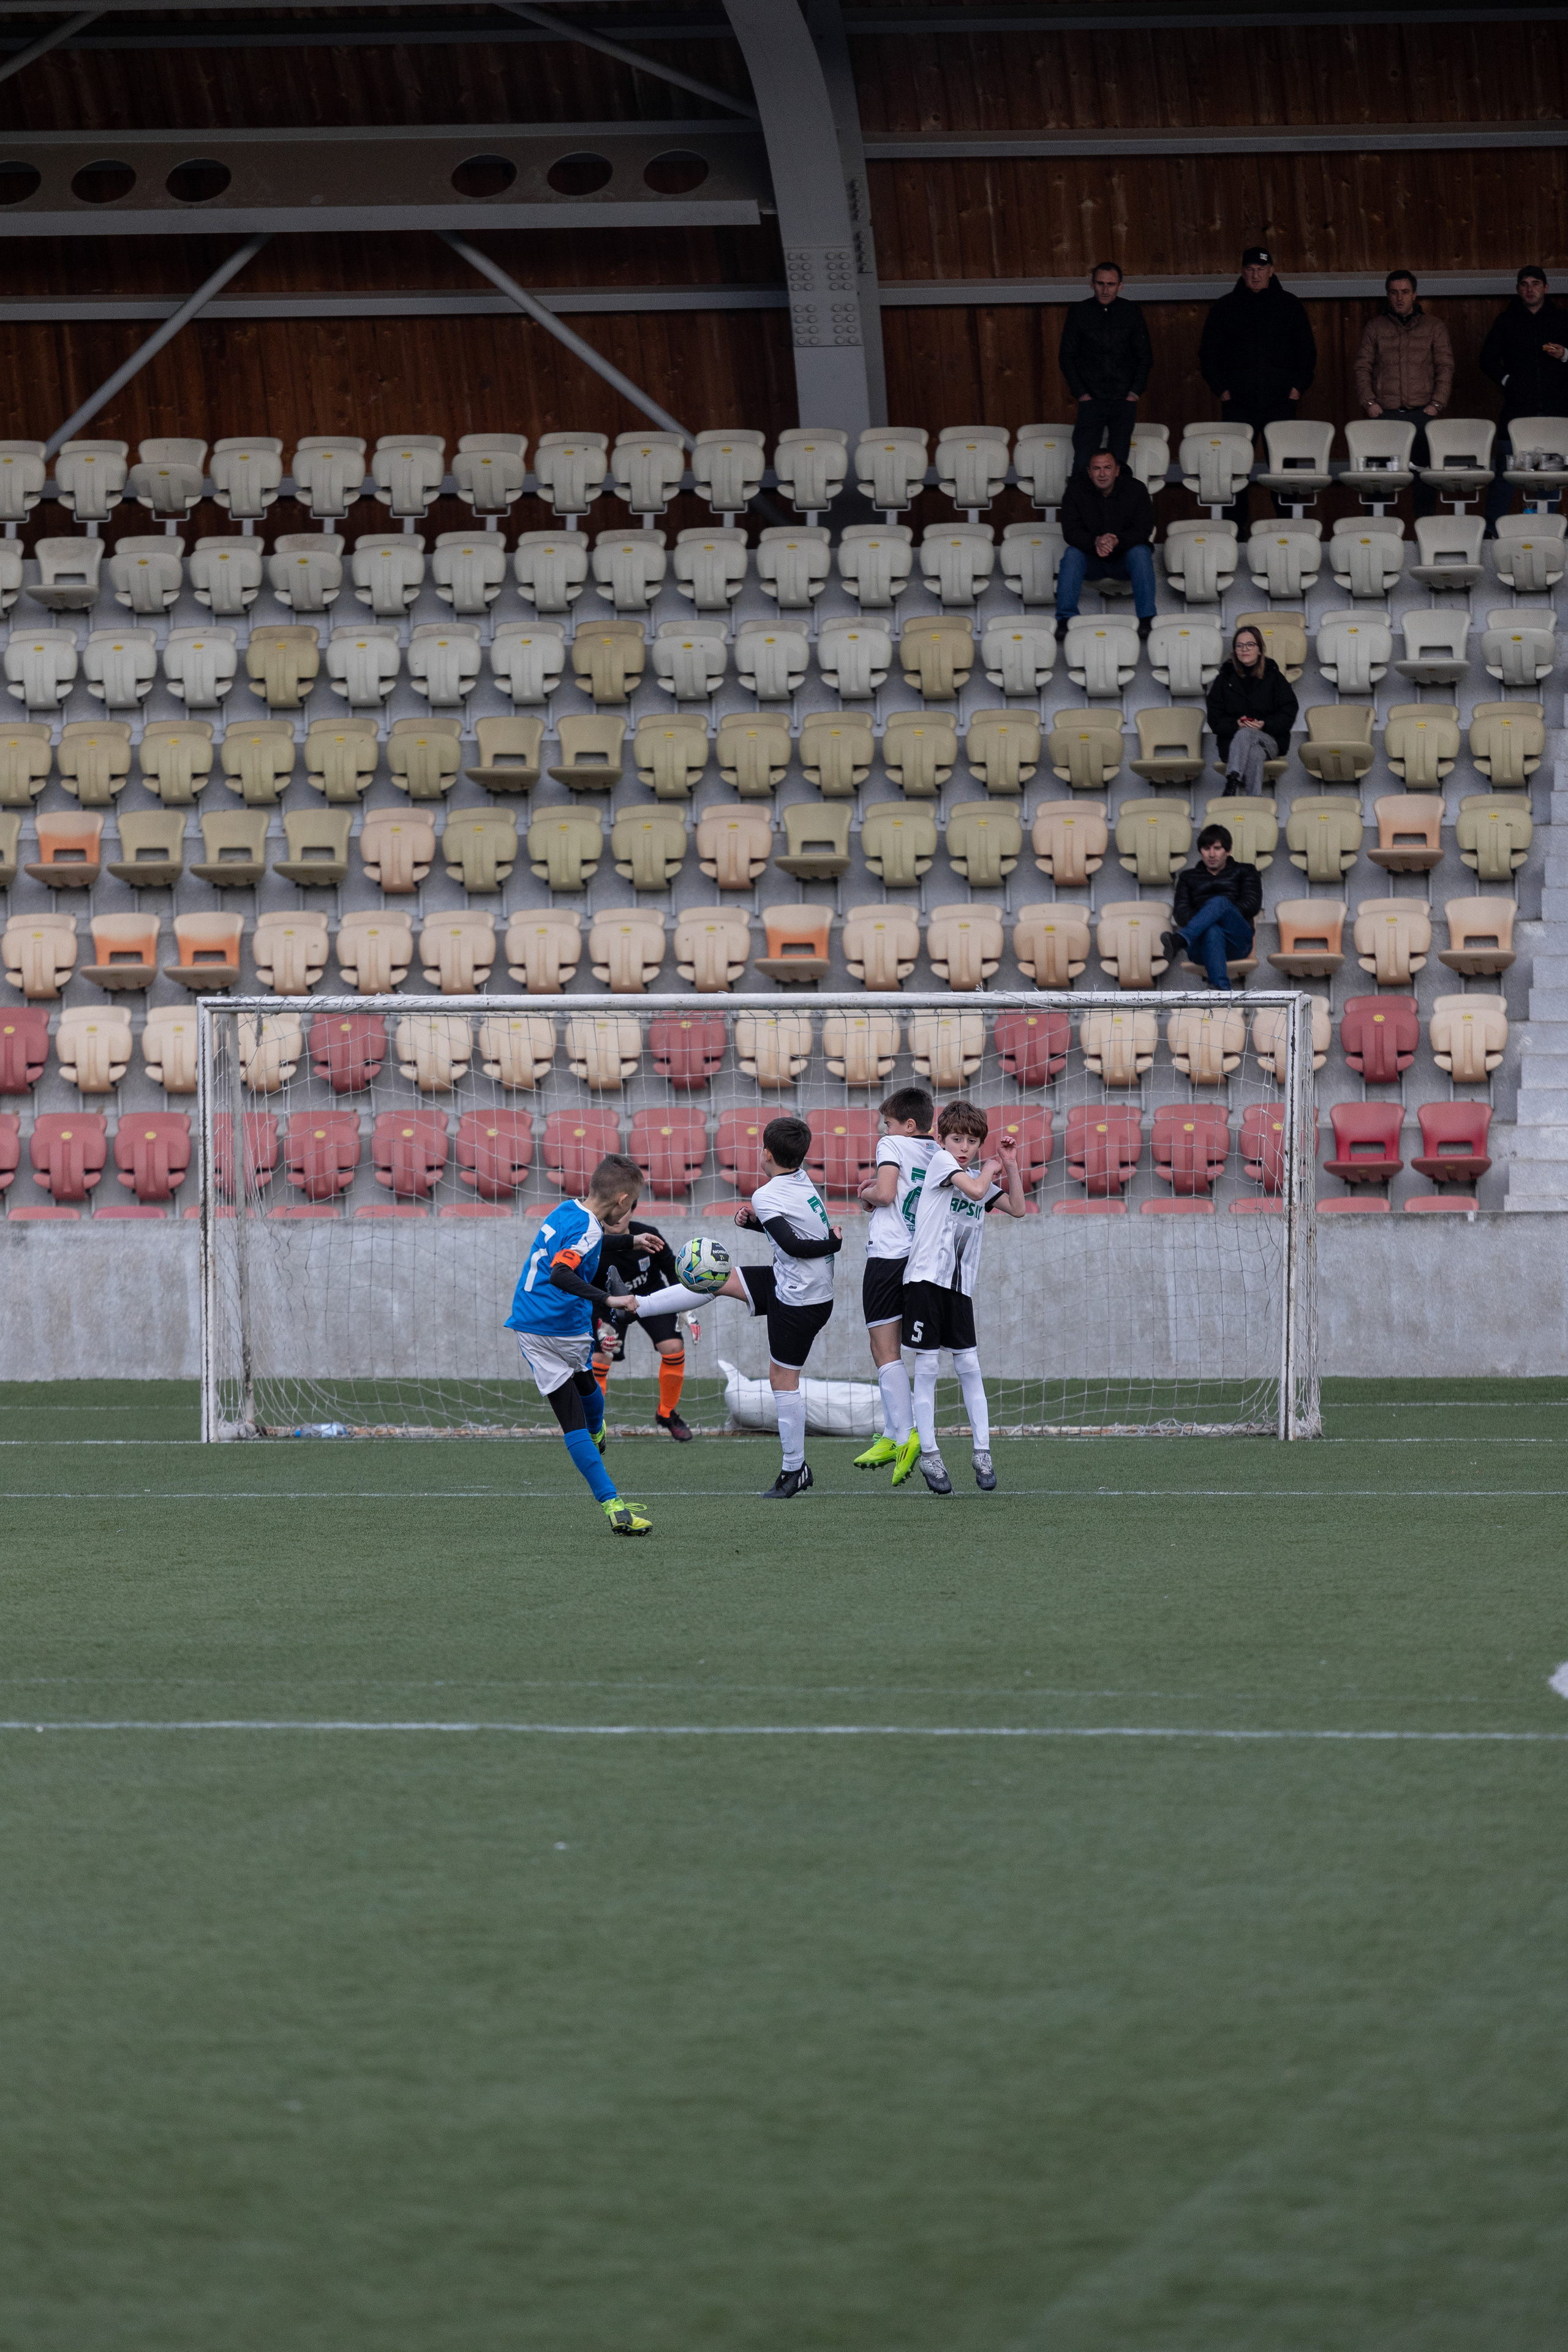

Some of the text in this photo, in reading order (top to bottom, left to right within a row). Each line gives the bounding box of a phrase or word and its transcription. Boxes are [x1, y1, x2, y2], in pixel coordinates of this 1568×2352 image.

[524, 1224, 556, 1292] 7
[562, 1251, 575, 1260] C
[625, 1272, 648, 1291] sny
[911, 1320, 924, 1343] 5
